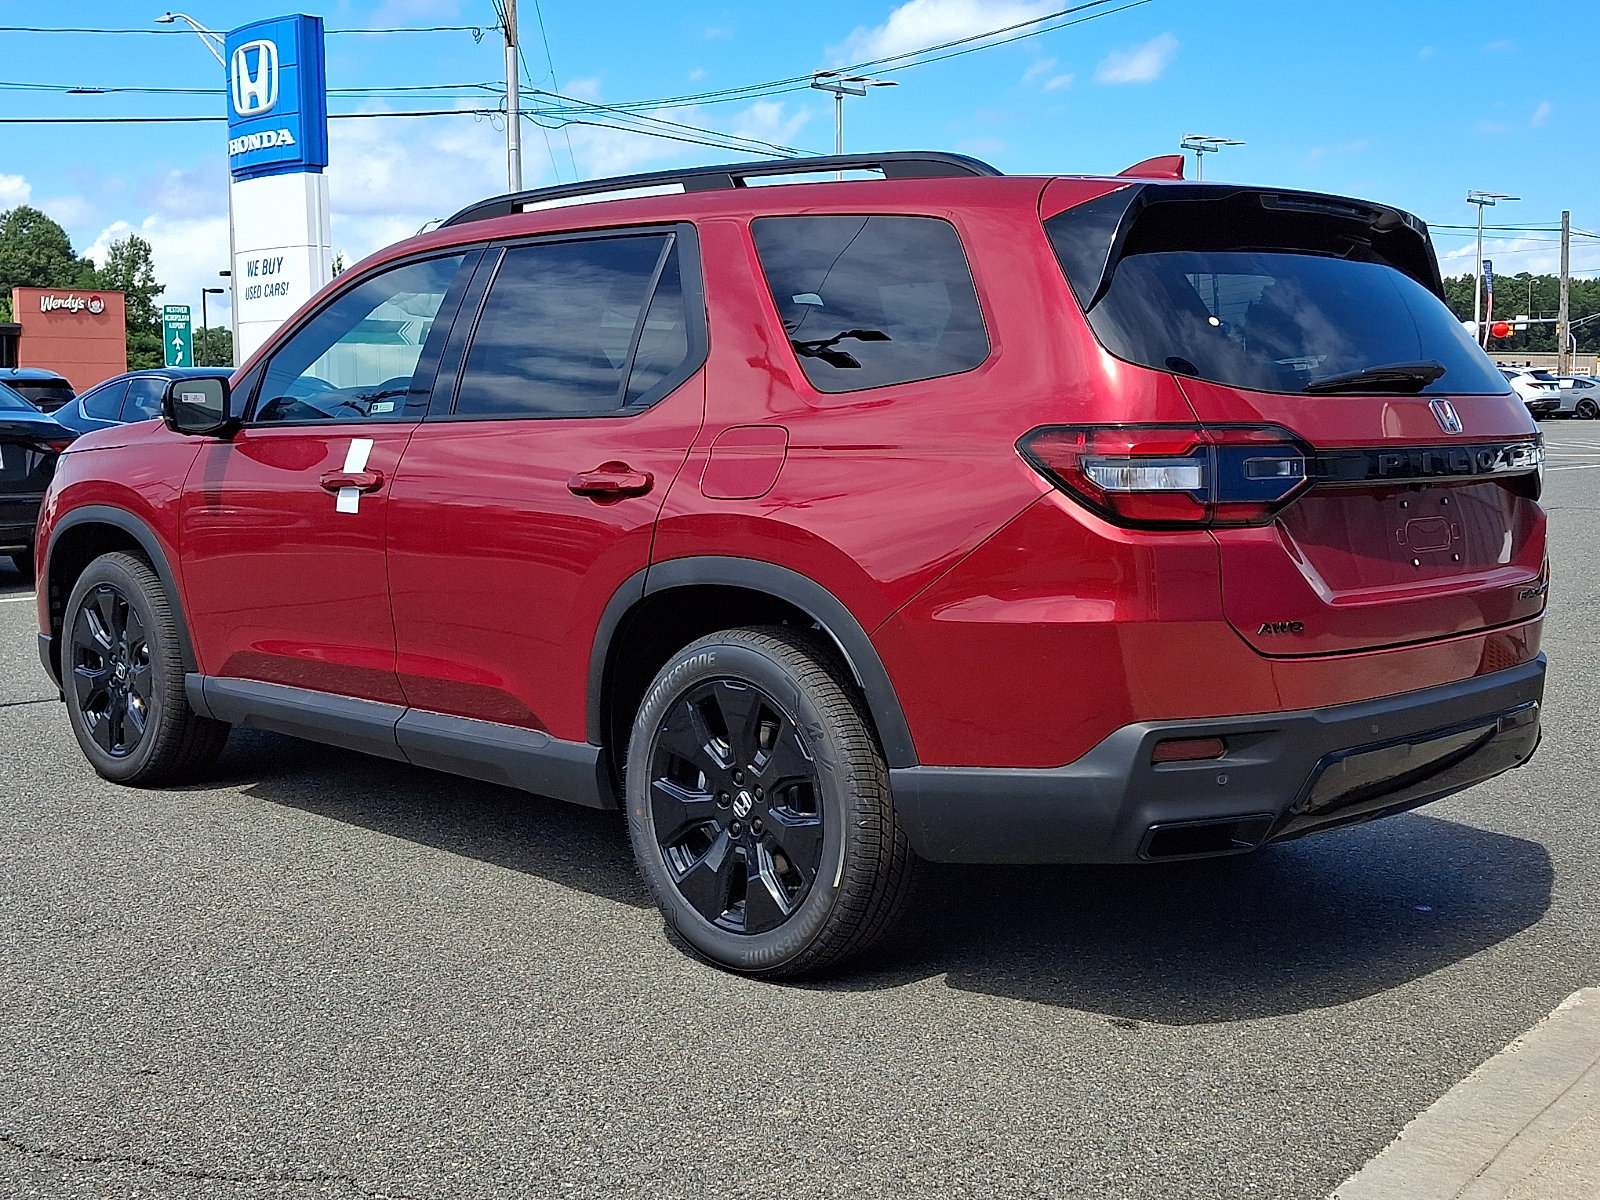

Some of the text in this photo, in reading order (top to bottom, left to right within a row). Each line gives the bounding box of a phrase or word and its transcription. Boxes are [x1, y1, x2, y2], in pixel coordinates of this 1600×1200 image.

[228, 128, 296, 156] HONDA
[247, 256, 284, 278] WE BUY
[245, 281, 290, 301] USED CARS!
[40, 293, 85, 313] Wendy's
[1378, 448, 1521, 476] PILOT
[1256, 620, 1304, 635] AWD
